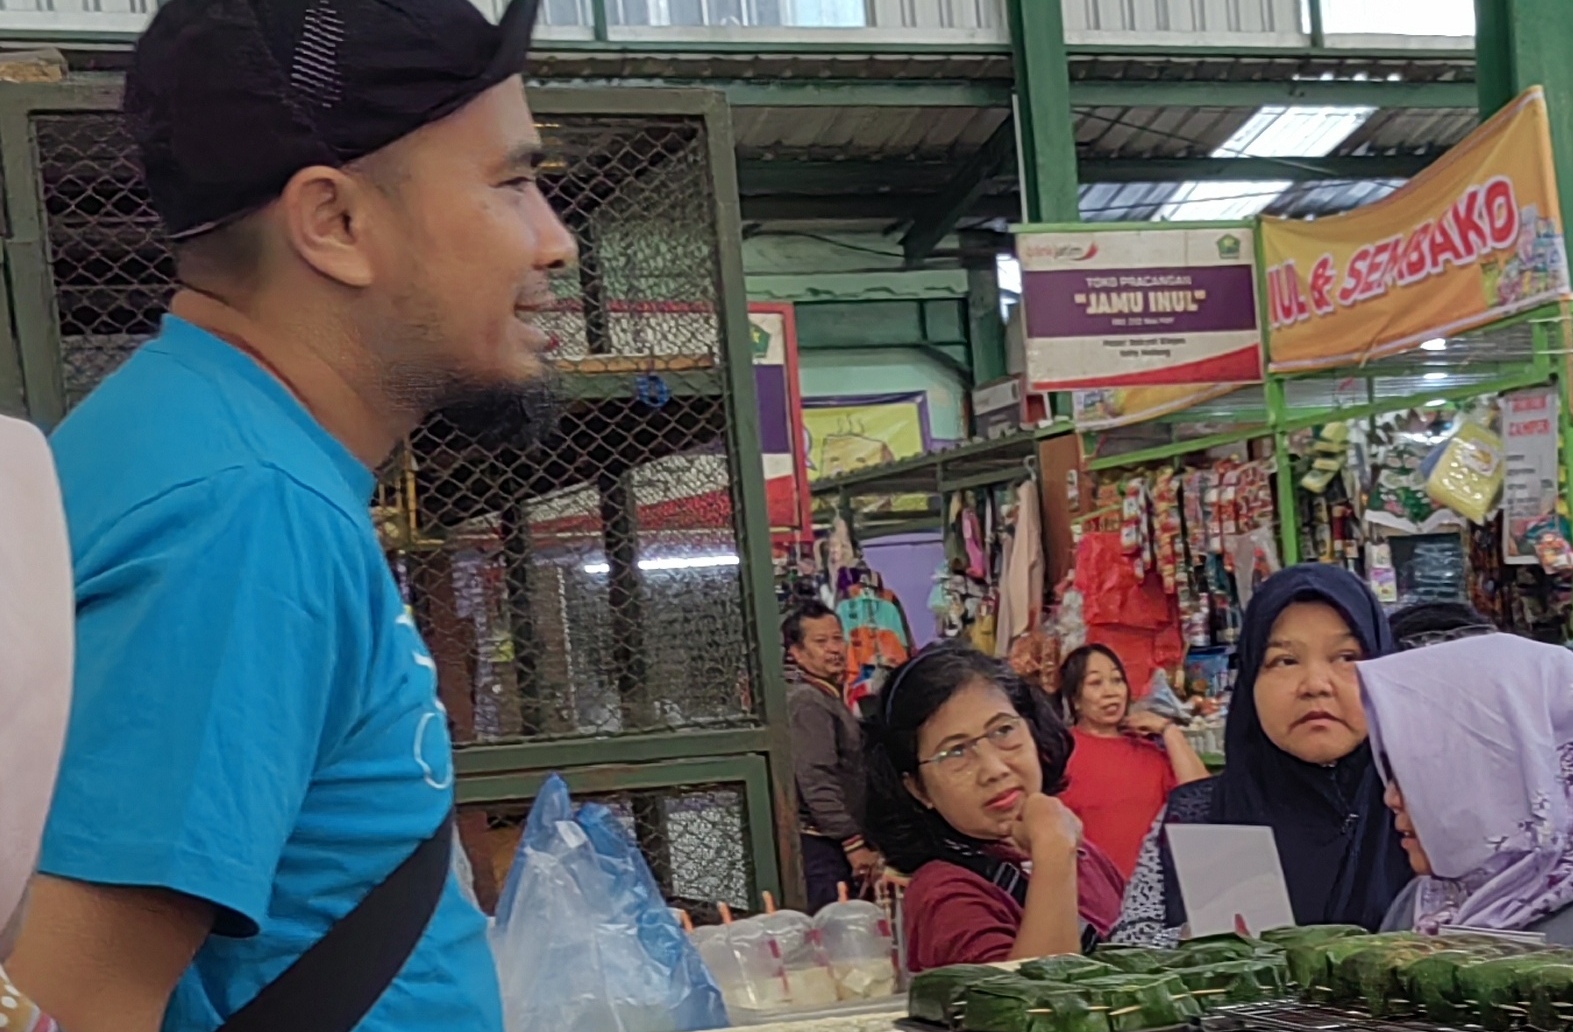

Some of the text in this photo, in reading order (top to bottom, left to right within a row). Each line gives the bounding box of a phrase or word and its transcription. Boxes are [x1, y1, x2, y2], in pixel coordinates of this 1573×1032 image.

[1309, 253, 1336, 314] &
[1337, 175, 1521, 306] SEMBAKO
[1073, 289, 1207, 315] "JAMU INUL"
